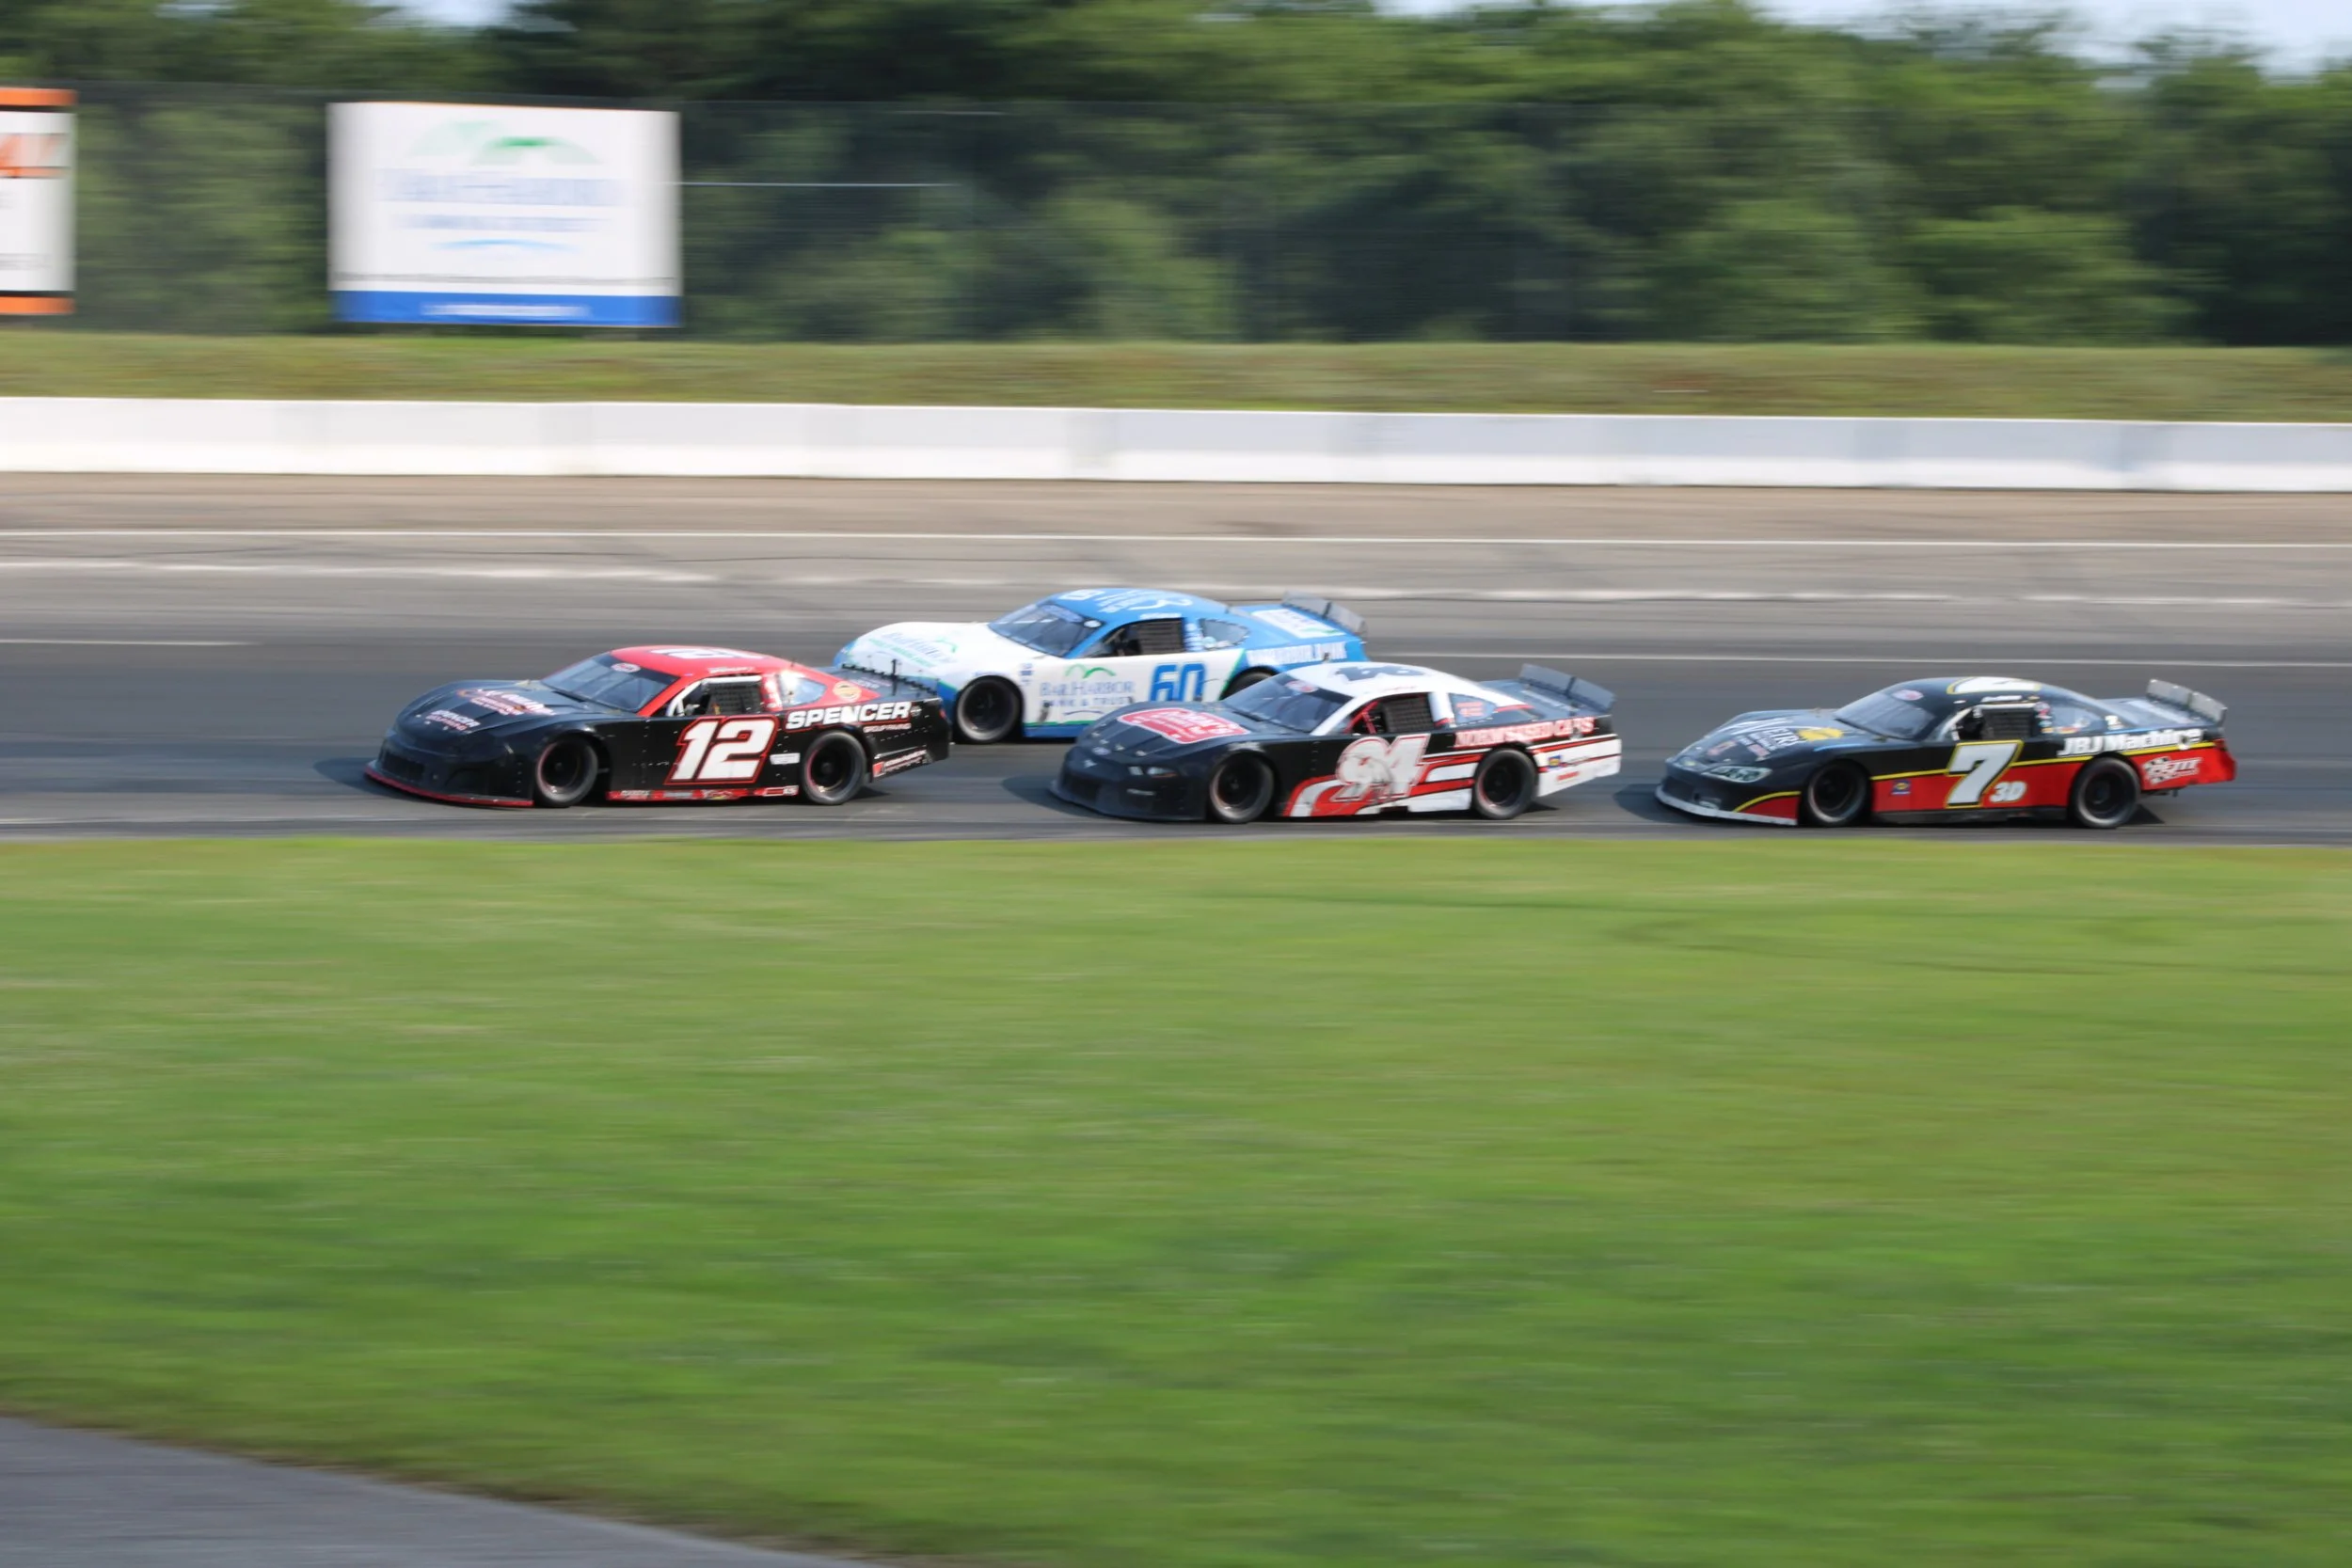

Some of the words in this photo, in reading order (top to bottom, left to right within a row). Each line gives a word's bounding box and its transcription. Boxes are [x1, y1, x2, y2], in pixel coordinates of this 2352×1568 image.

[1149, 662, 1205, 703] 60
[786, 701, 912, 730] SPENCER
[665, 717, 778, 784] 12
[2058, 734, 2105, 757] JBJ
[1330, 734, 1431, 802] 94
[1945, 740, 2024, 808] 7
[1989, 781, 2027, 802] 3D
